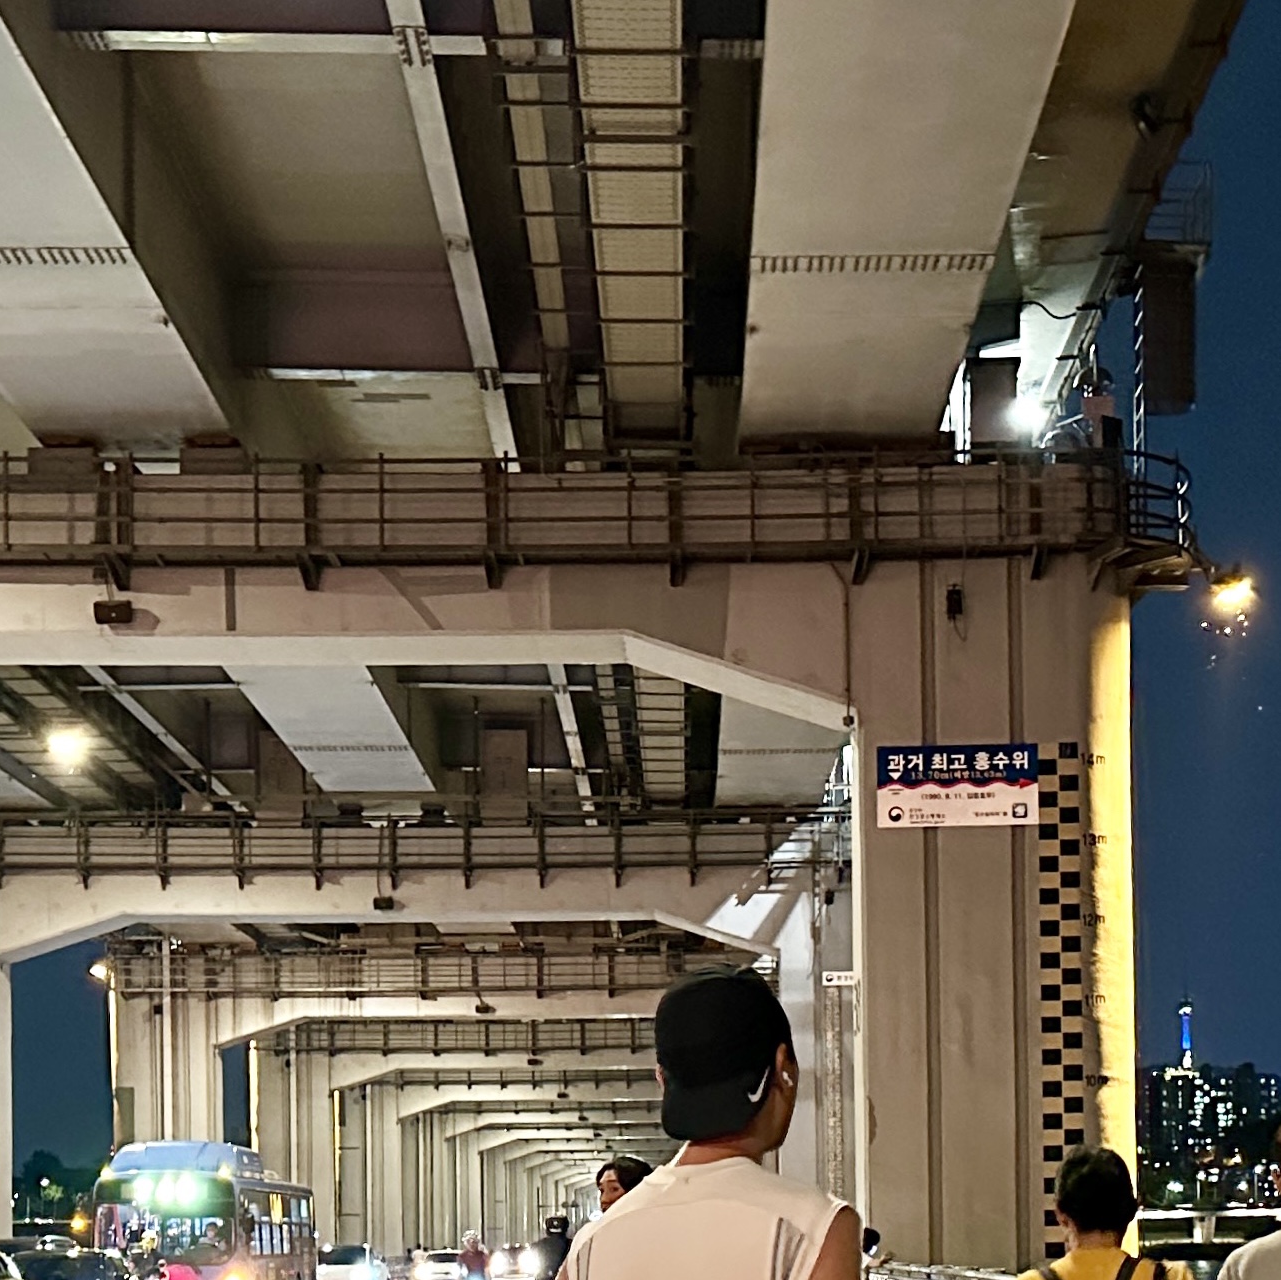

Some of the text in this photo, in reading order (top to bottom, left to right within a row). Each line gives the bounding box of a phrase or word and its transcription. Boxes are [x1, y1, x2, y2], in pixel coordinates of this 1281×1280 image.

[887, 751, 1029, 772] 과거 최고 홍수위
[1080, 753, 1106, 766] 14m
[1082, 833, 1108, 846] 13m
[1082, 912, 1106, 927] 12m
[1084, 994, 1106, 1007] 11m
[1085, 1074, 1109, 1087] 10m
